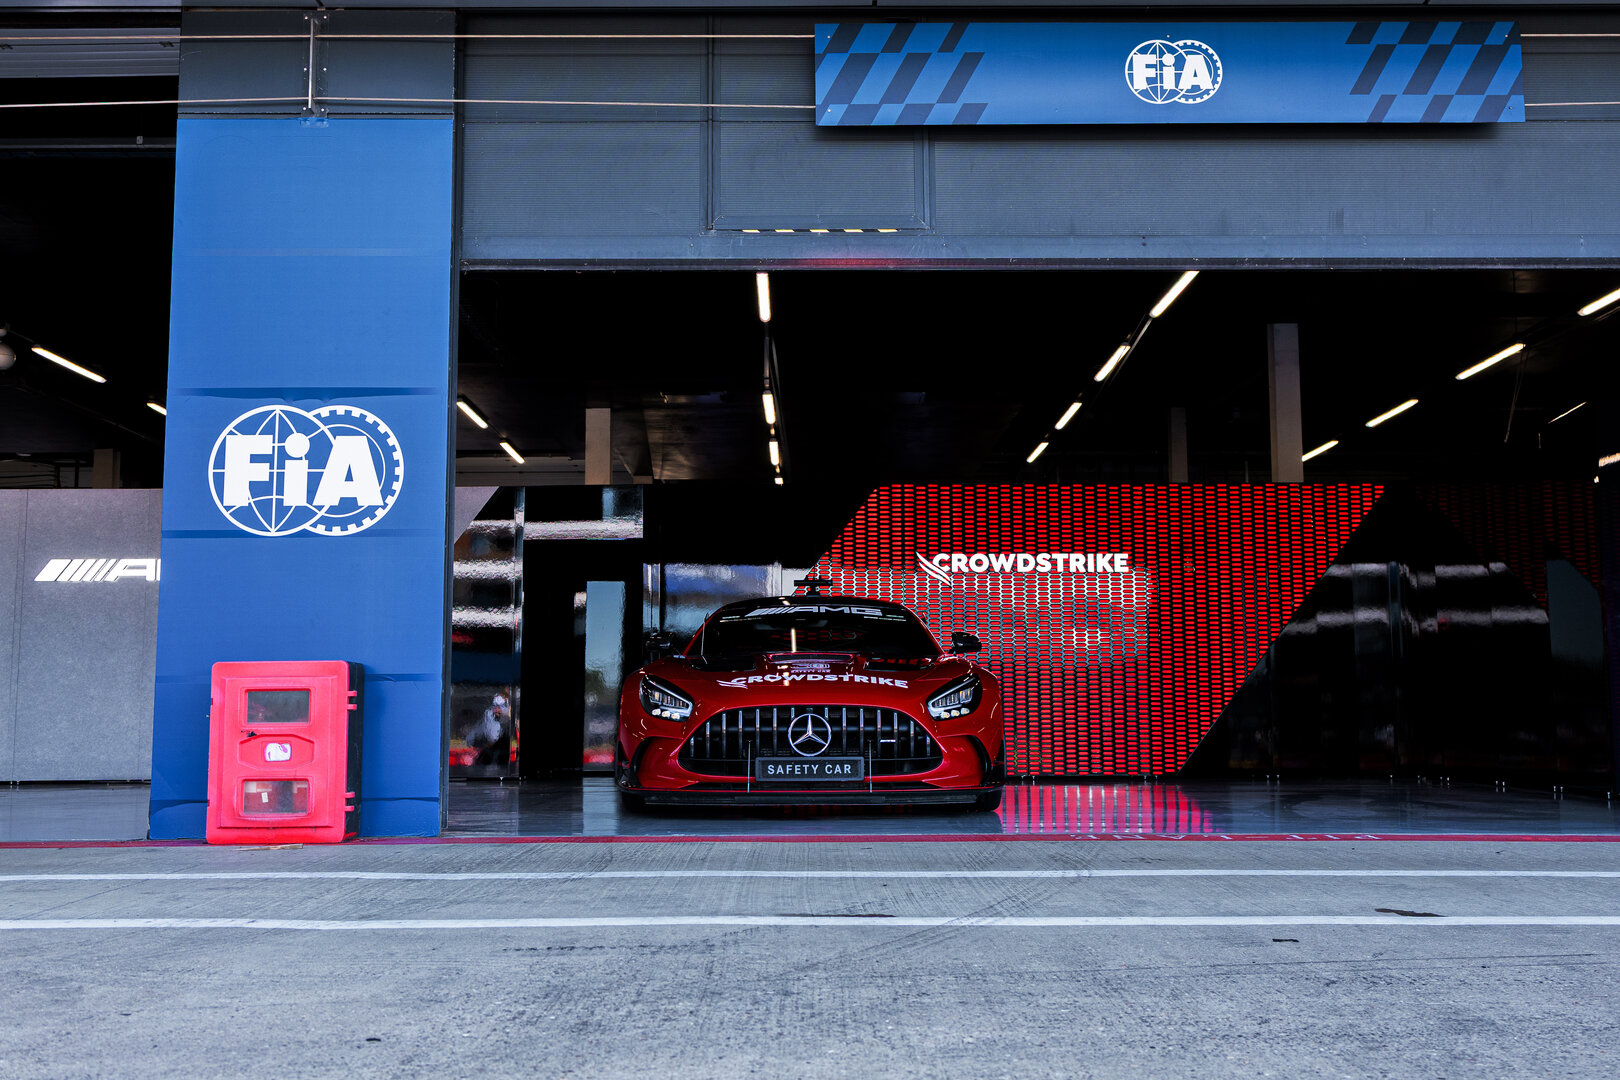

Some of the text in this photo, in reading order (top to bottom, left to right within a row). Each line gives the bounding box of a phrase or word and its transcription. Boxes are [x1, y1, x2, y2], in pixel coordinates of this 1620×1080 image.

[932, 553, 1130, 572] CROWDSTRIKE
[787, 605, 883, 616] AMG
[730, 674, 909, 688] CROWDSTRIKE
[767, 764, 852, 775] SAFETY CAR
